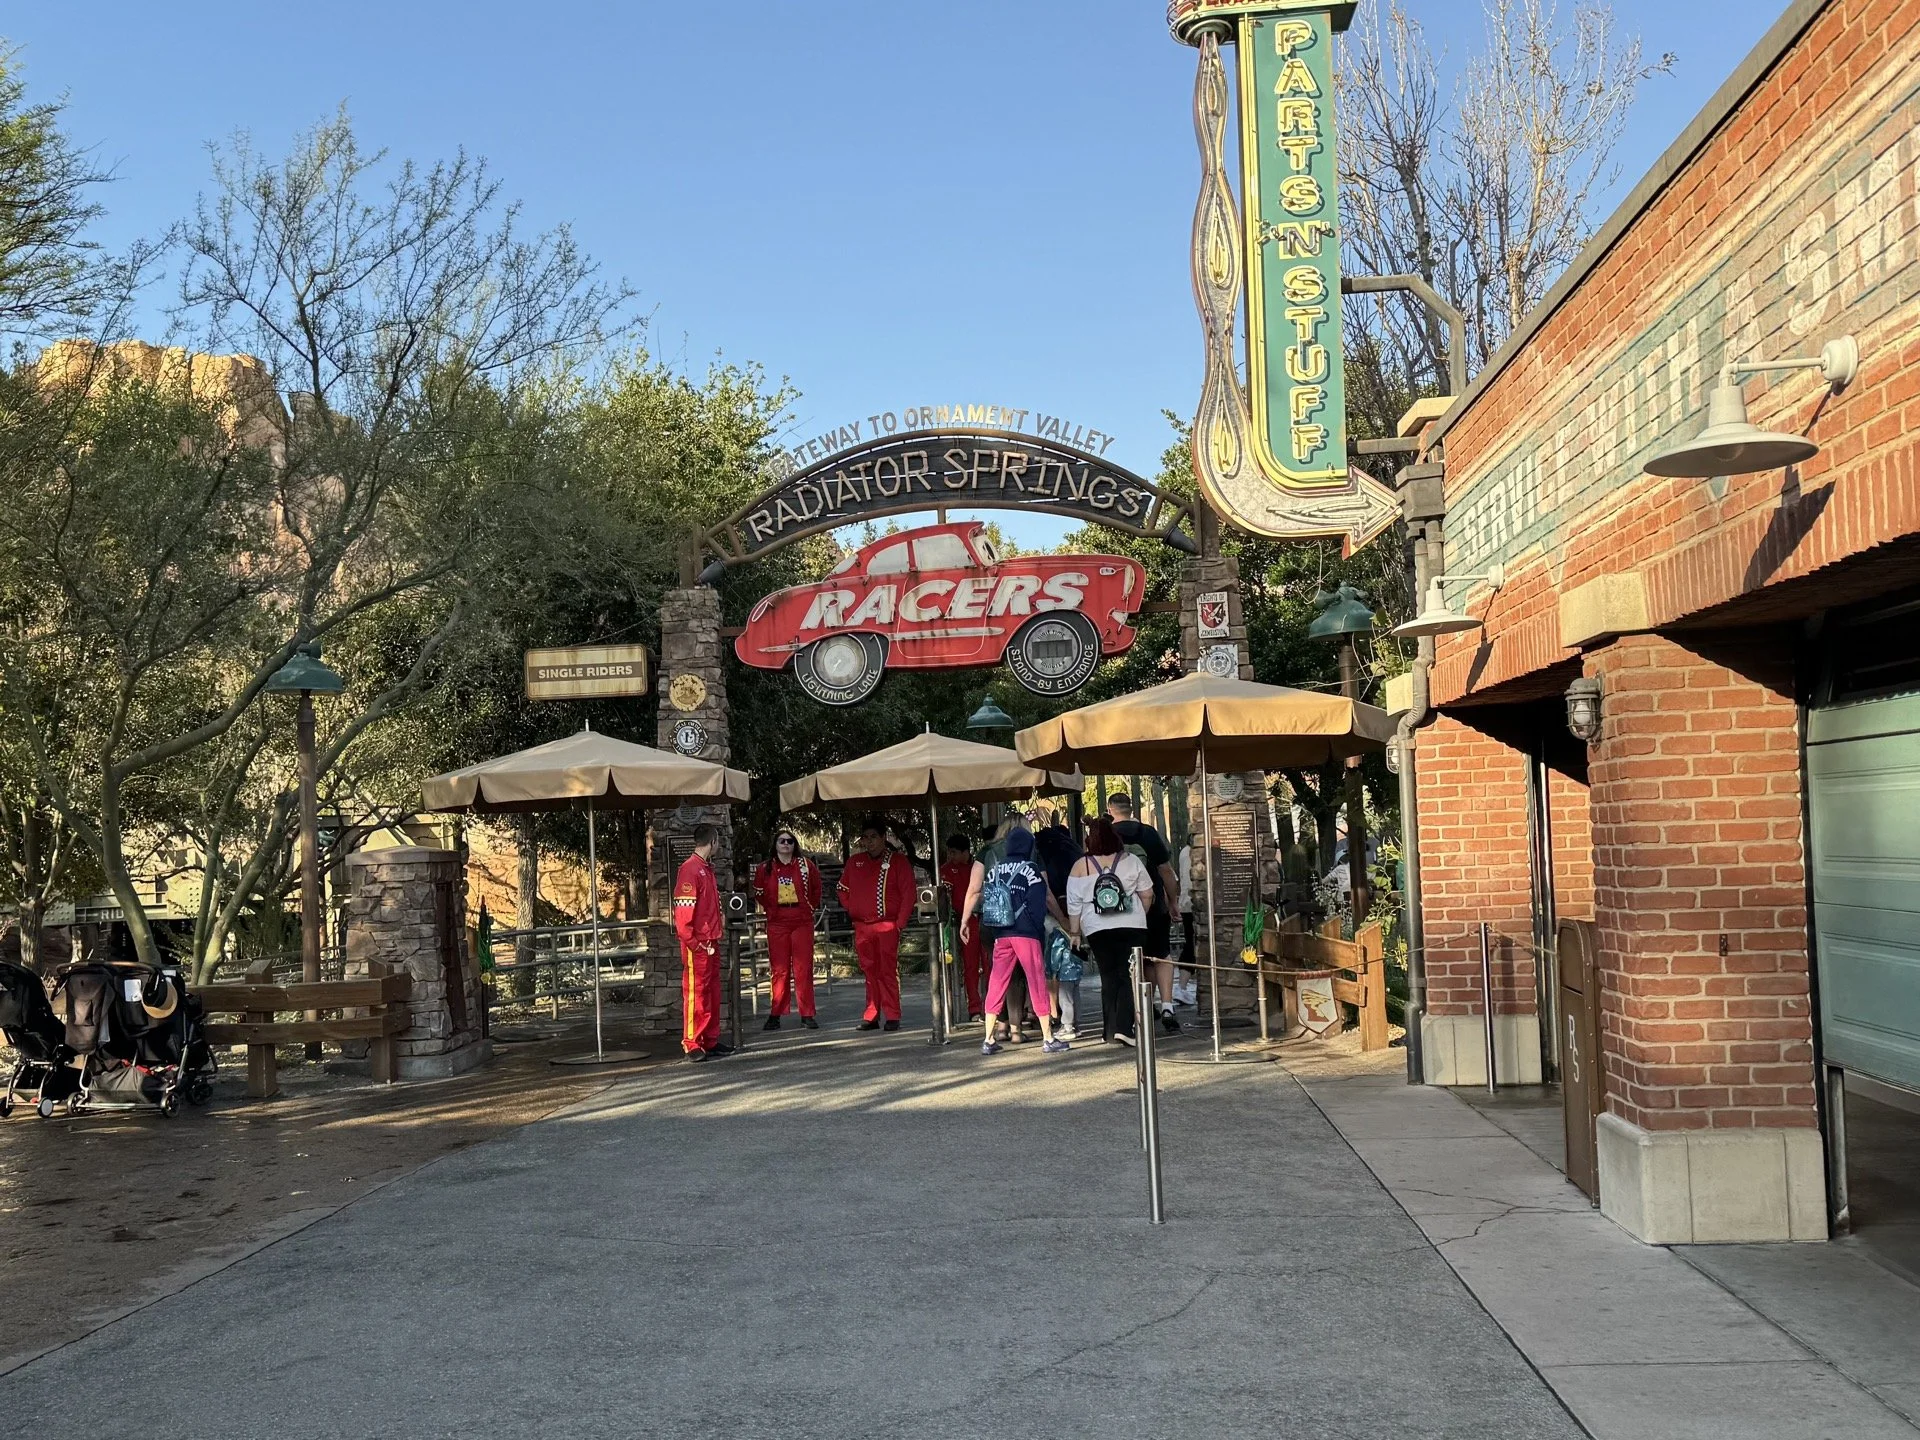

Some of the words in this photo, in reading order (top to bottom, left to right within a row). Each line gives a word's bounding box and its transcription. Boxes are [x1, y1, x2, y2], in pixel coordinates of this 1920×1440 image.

[1274, 20, 1322, 213] PARTS
[1282, 265, 1329, 461] STUFF
[770, 421, 861, 479] GATEWAY
[868, 412, 898, 435] TO
[904, 404, 1030, 428] ORNAMENT
[1035, 413, 1115, 454] VALLEY
[1464, 423, 1577, 565] SERVICE
[1584, 315, 1702, 478] WITH
[1724, 271, 1769, 391] A
[746, 449, 932, 543] RADIATOR
[943, 448, 1145, 517] SPRINGS
[800, 572, 1089, 630] RACERS
[538, 668, 584, 680] SINGLE
[586, 665, 633, 677] RIDERS
[801, 672, 855, 701] LIGHTNING
[857, 669, 878, 693] LANE
[1011, 648, 1052, 690] STAND-BY
[1057, 643, 1094, 689] ENTRANCE
[100, 909, 125, 920] RID
